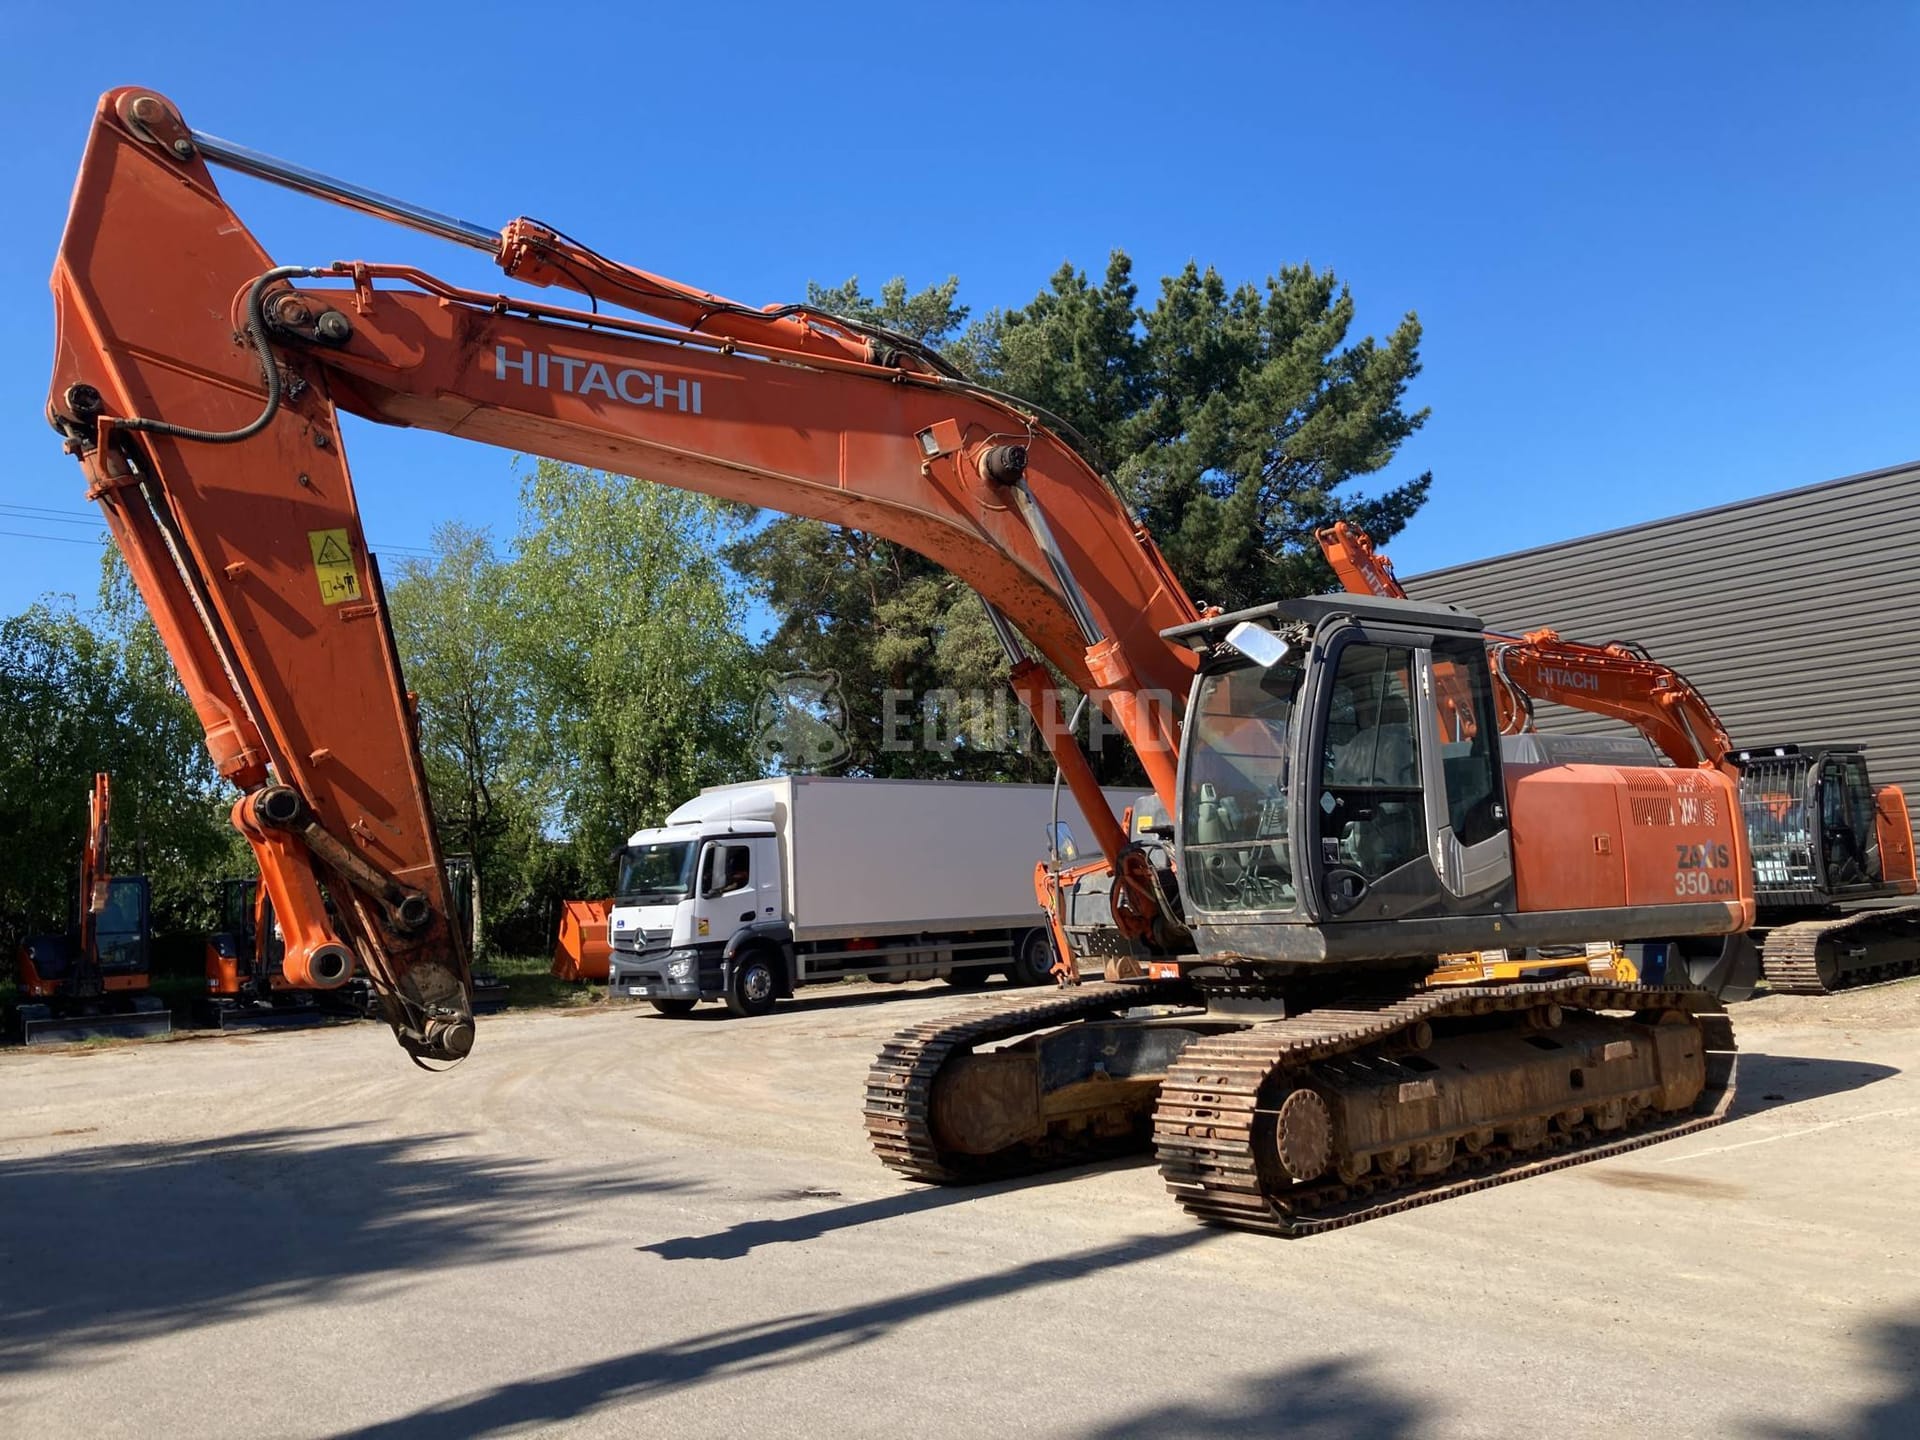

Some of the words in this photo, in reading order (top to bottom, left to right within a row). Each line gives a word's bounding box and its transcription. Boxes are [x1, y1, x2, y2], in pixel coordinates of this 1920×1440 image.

[496, 345, 702, 413] HITACHI
[1538, 667, 1597, 690] HITACHI
[1676, 839, 1729, 869] ZAXIS
